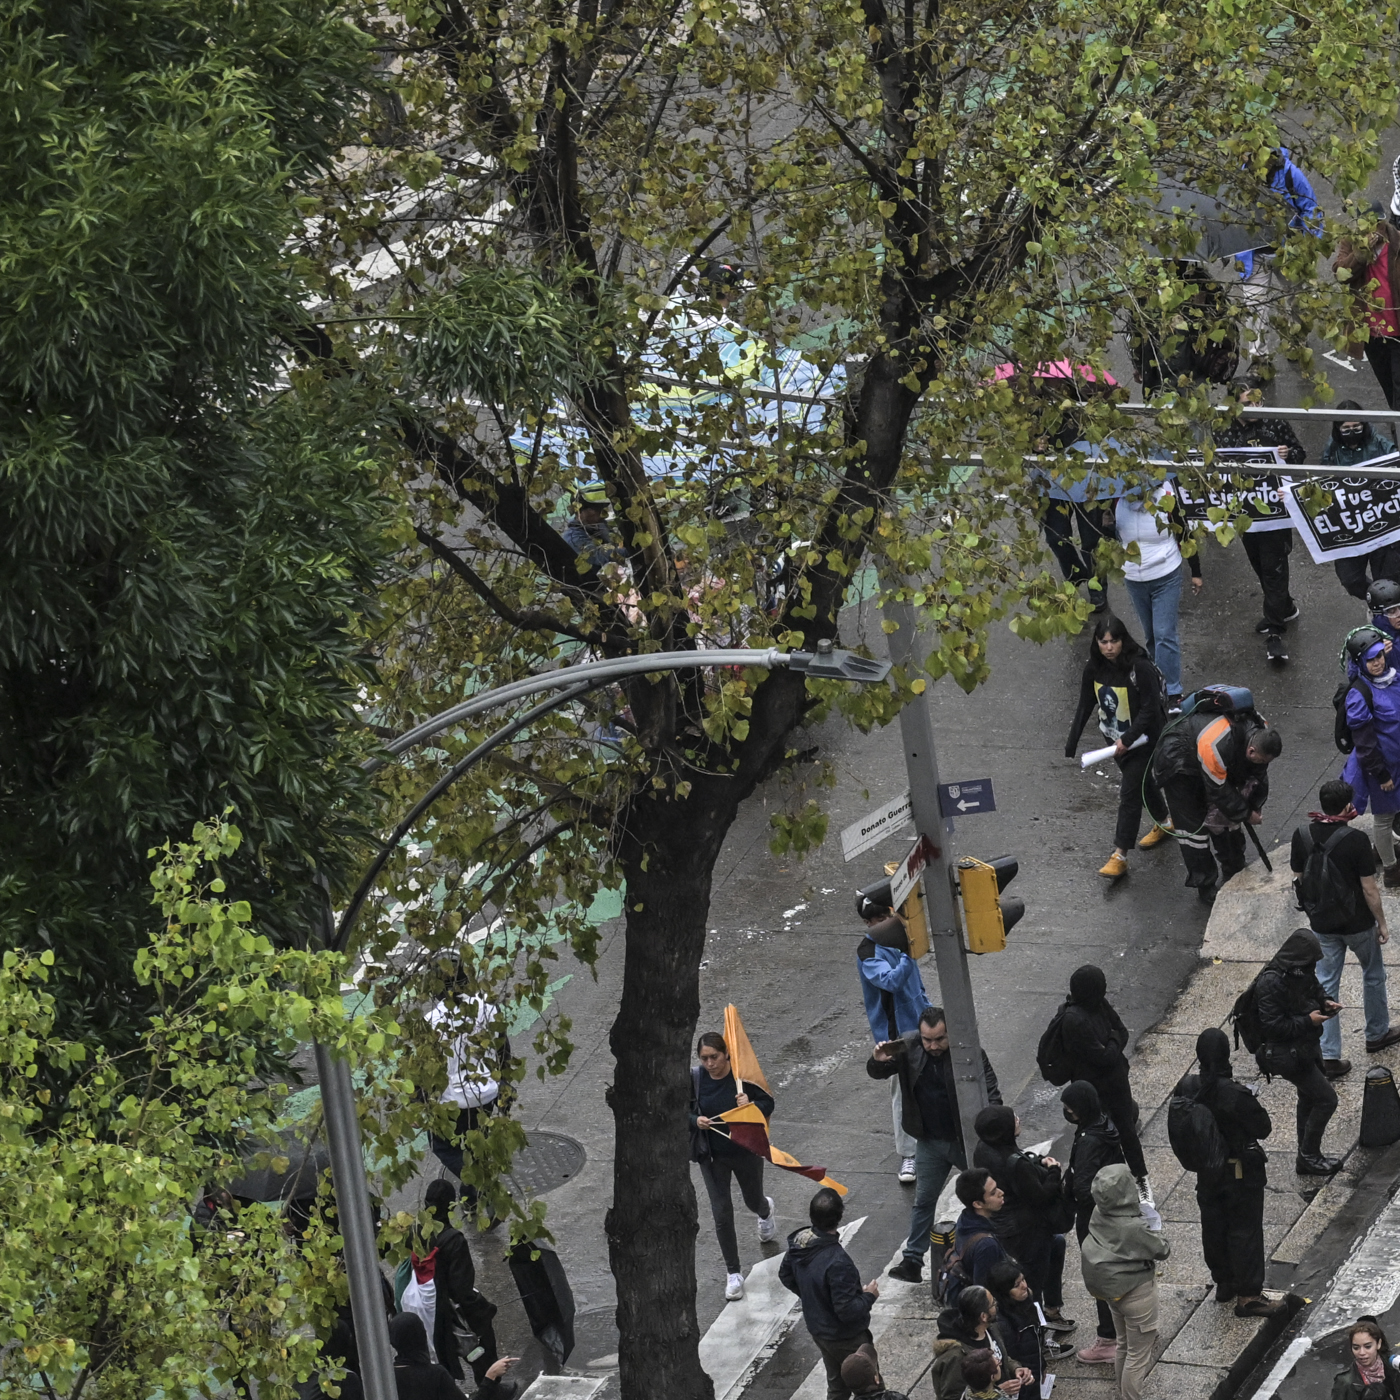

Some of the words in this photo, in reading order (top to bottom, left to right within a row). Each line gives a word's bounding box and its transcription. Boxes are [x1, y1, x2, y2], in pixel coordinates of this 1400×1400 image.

[1336, 488, 1373, 510] Fue
[861, 817, 887, 836] Donato
[887, 801, 912, 820] Guerra
